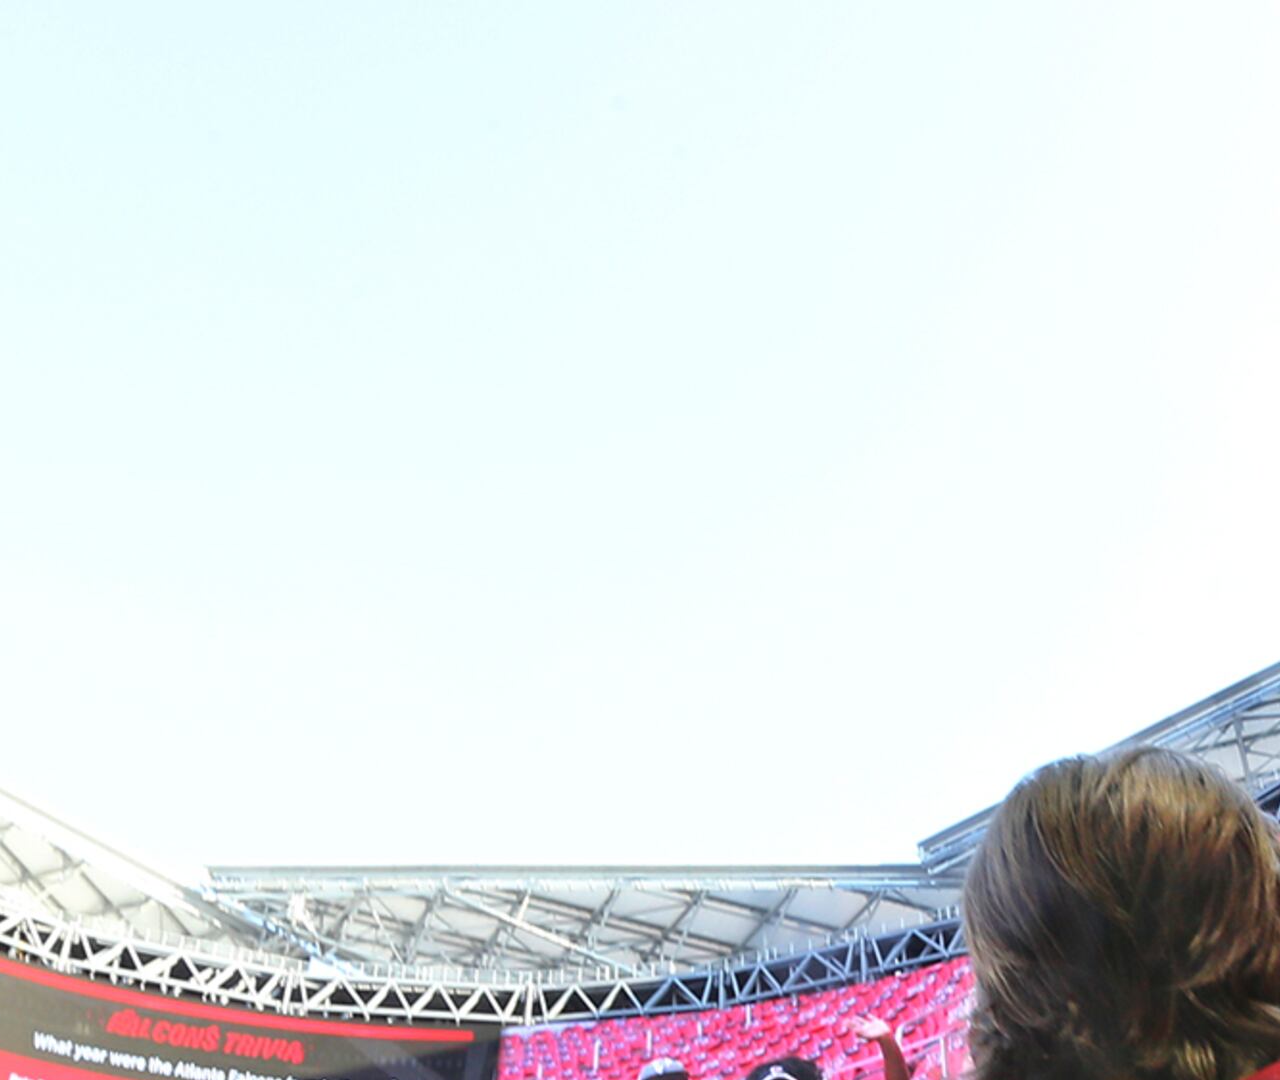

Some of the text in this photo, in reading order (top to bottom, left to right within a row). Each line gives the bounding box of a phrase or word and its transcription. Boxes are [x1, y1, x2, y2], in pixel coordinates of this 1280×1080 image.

[33, 1031, 73, 1057] What
[73, 1043, 108, 1063] year
[109, 1051, 147, 1073] were
[148, 1055, 174, 1077] the
[106, 1008, 305, 1065] FALCONS TRIVIA
